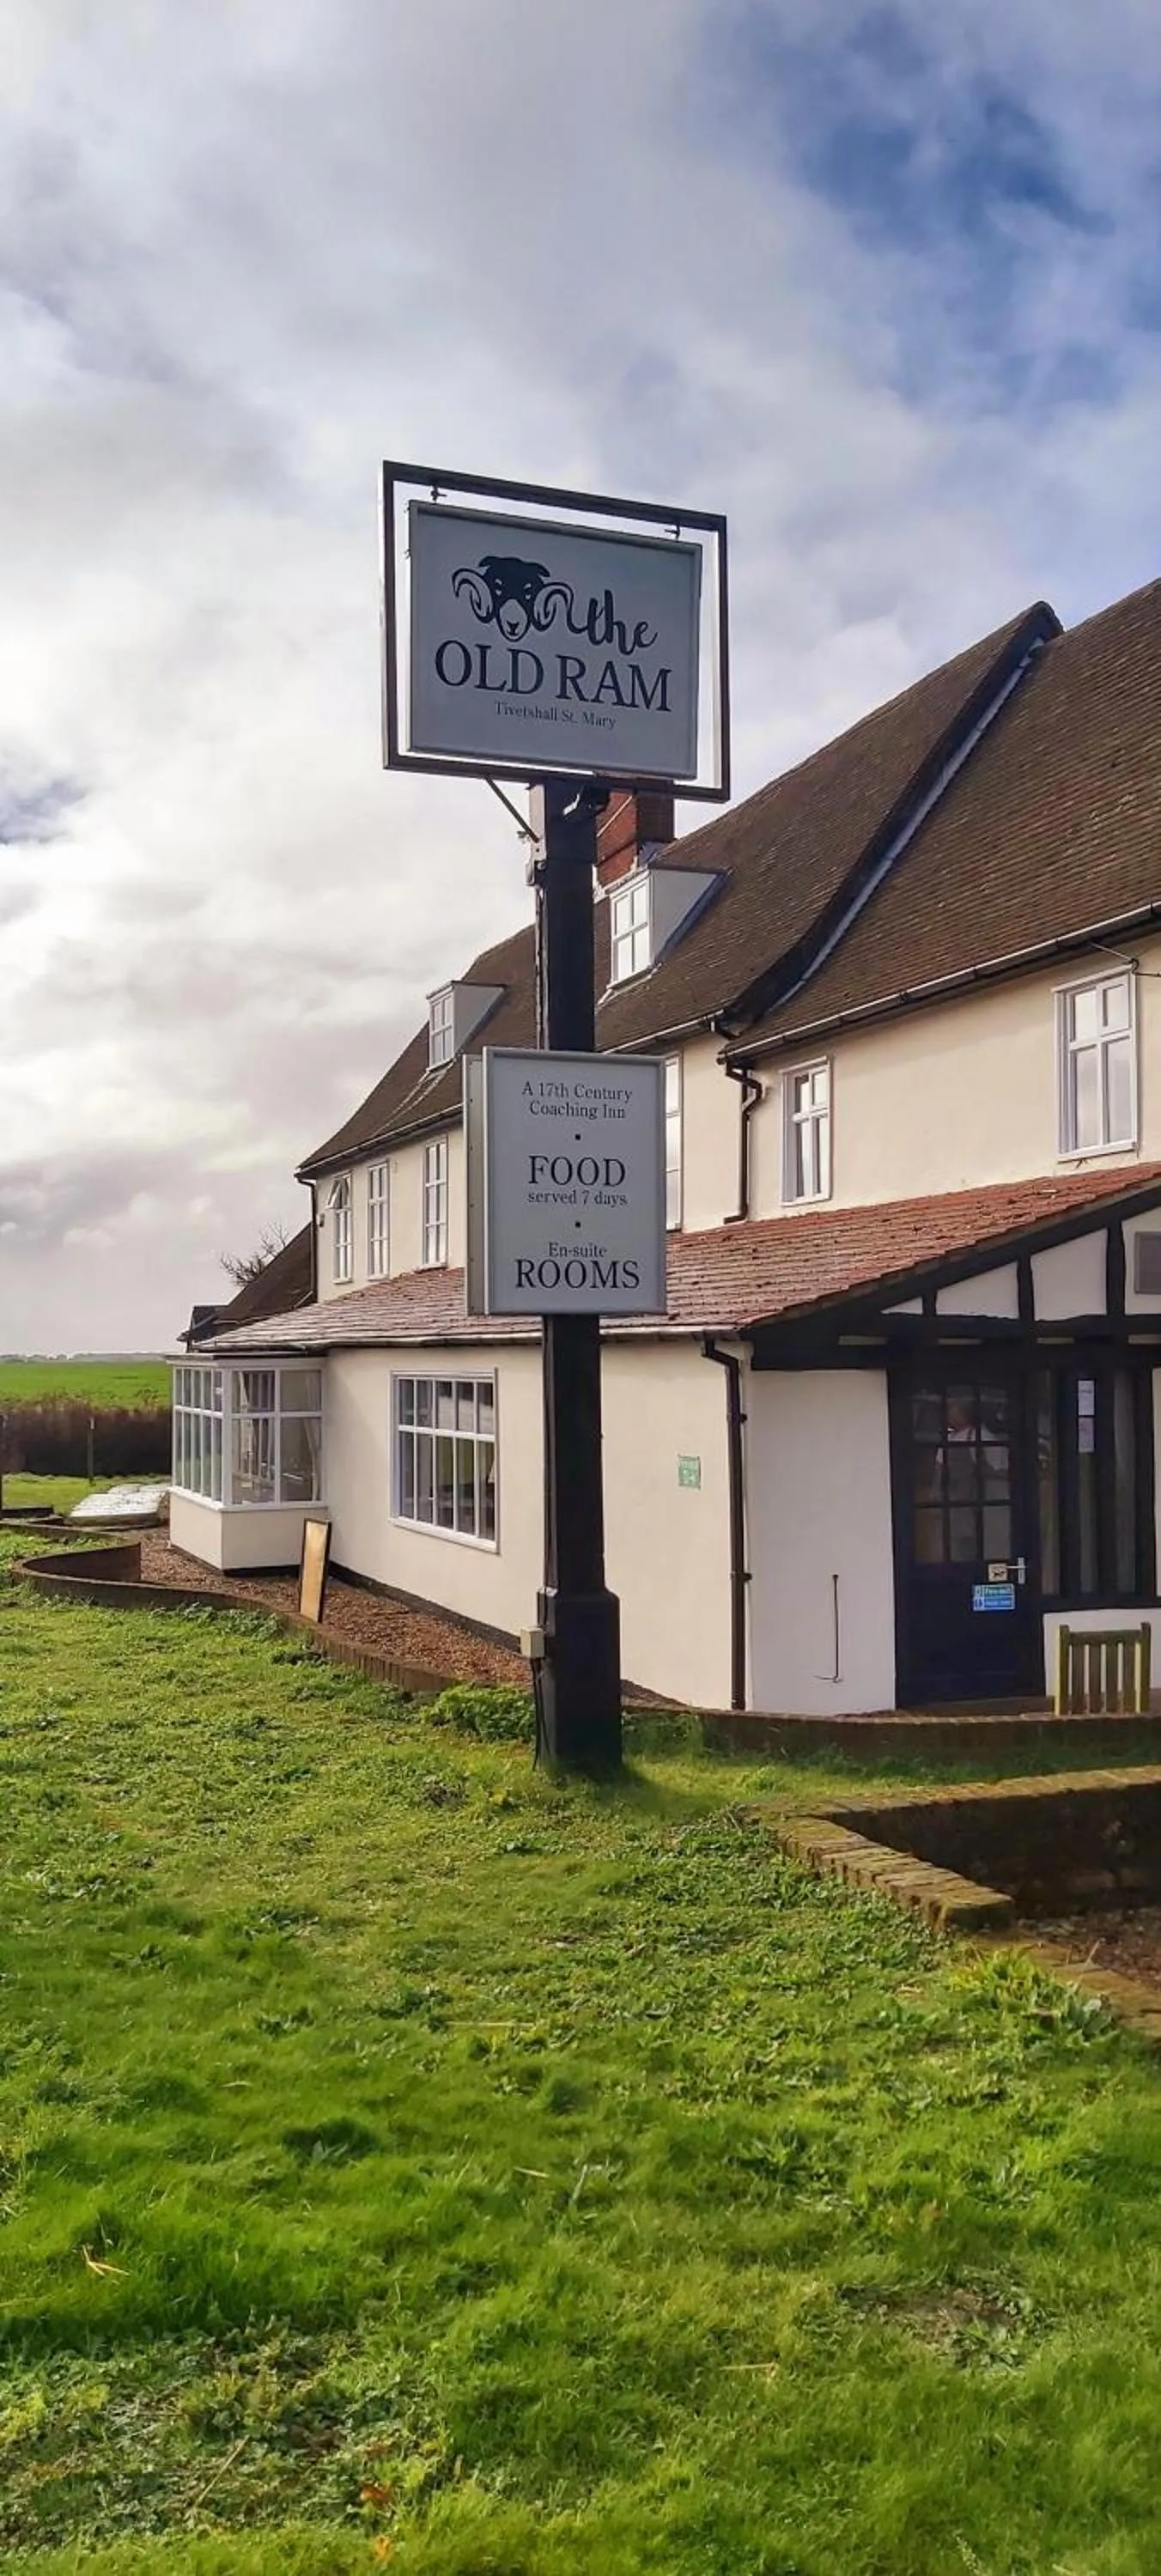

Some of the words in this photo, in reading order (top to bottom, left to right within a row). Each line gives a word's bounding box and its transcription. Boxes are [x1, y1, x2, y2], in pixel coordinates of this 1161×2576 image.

[587, 589, 658, 655] the
[435, 640, 544, 695] OLD
[555, 654, 673, 712] RAM
[495, 701, 557, 721] Tivetshall
[582, 711, 617, 730] Mary
[522, 1080, 533, 1096] A
[539, 1082, 568, 1098] 17th
[574, 1084, 632, 1104] Century
[530, 1100, 599, 1120] Coaching
[603, 1103, 625, 1118] Inn
[528, 1155, 626, 1187] FOOD
[527, 1190, 576, 1204] served
[581, 1189, 590, 1205] 7
[593, 1191, 628, 1207] days
[549, 1242, 607, 1258] En-suite
[515, 1258, 641, 1290] ROOMS
